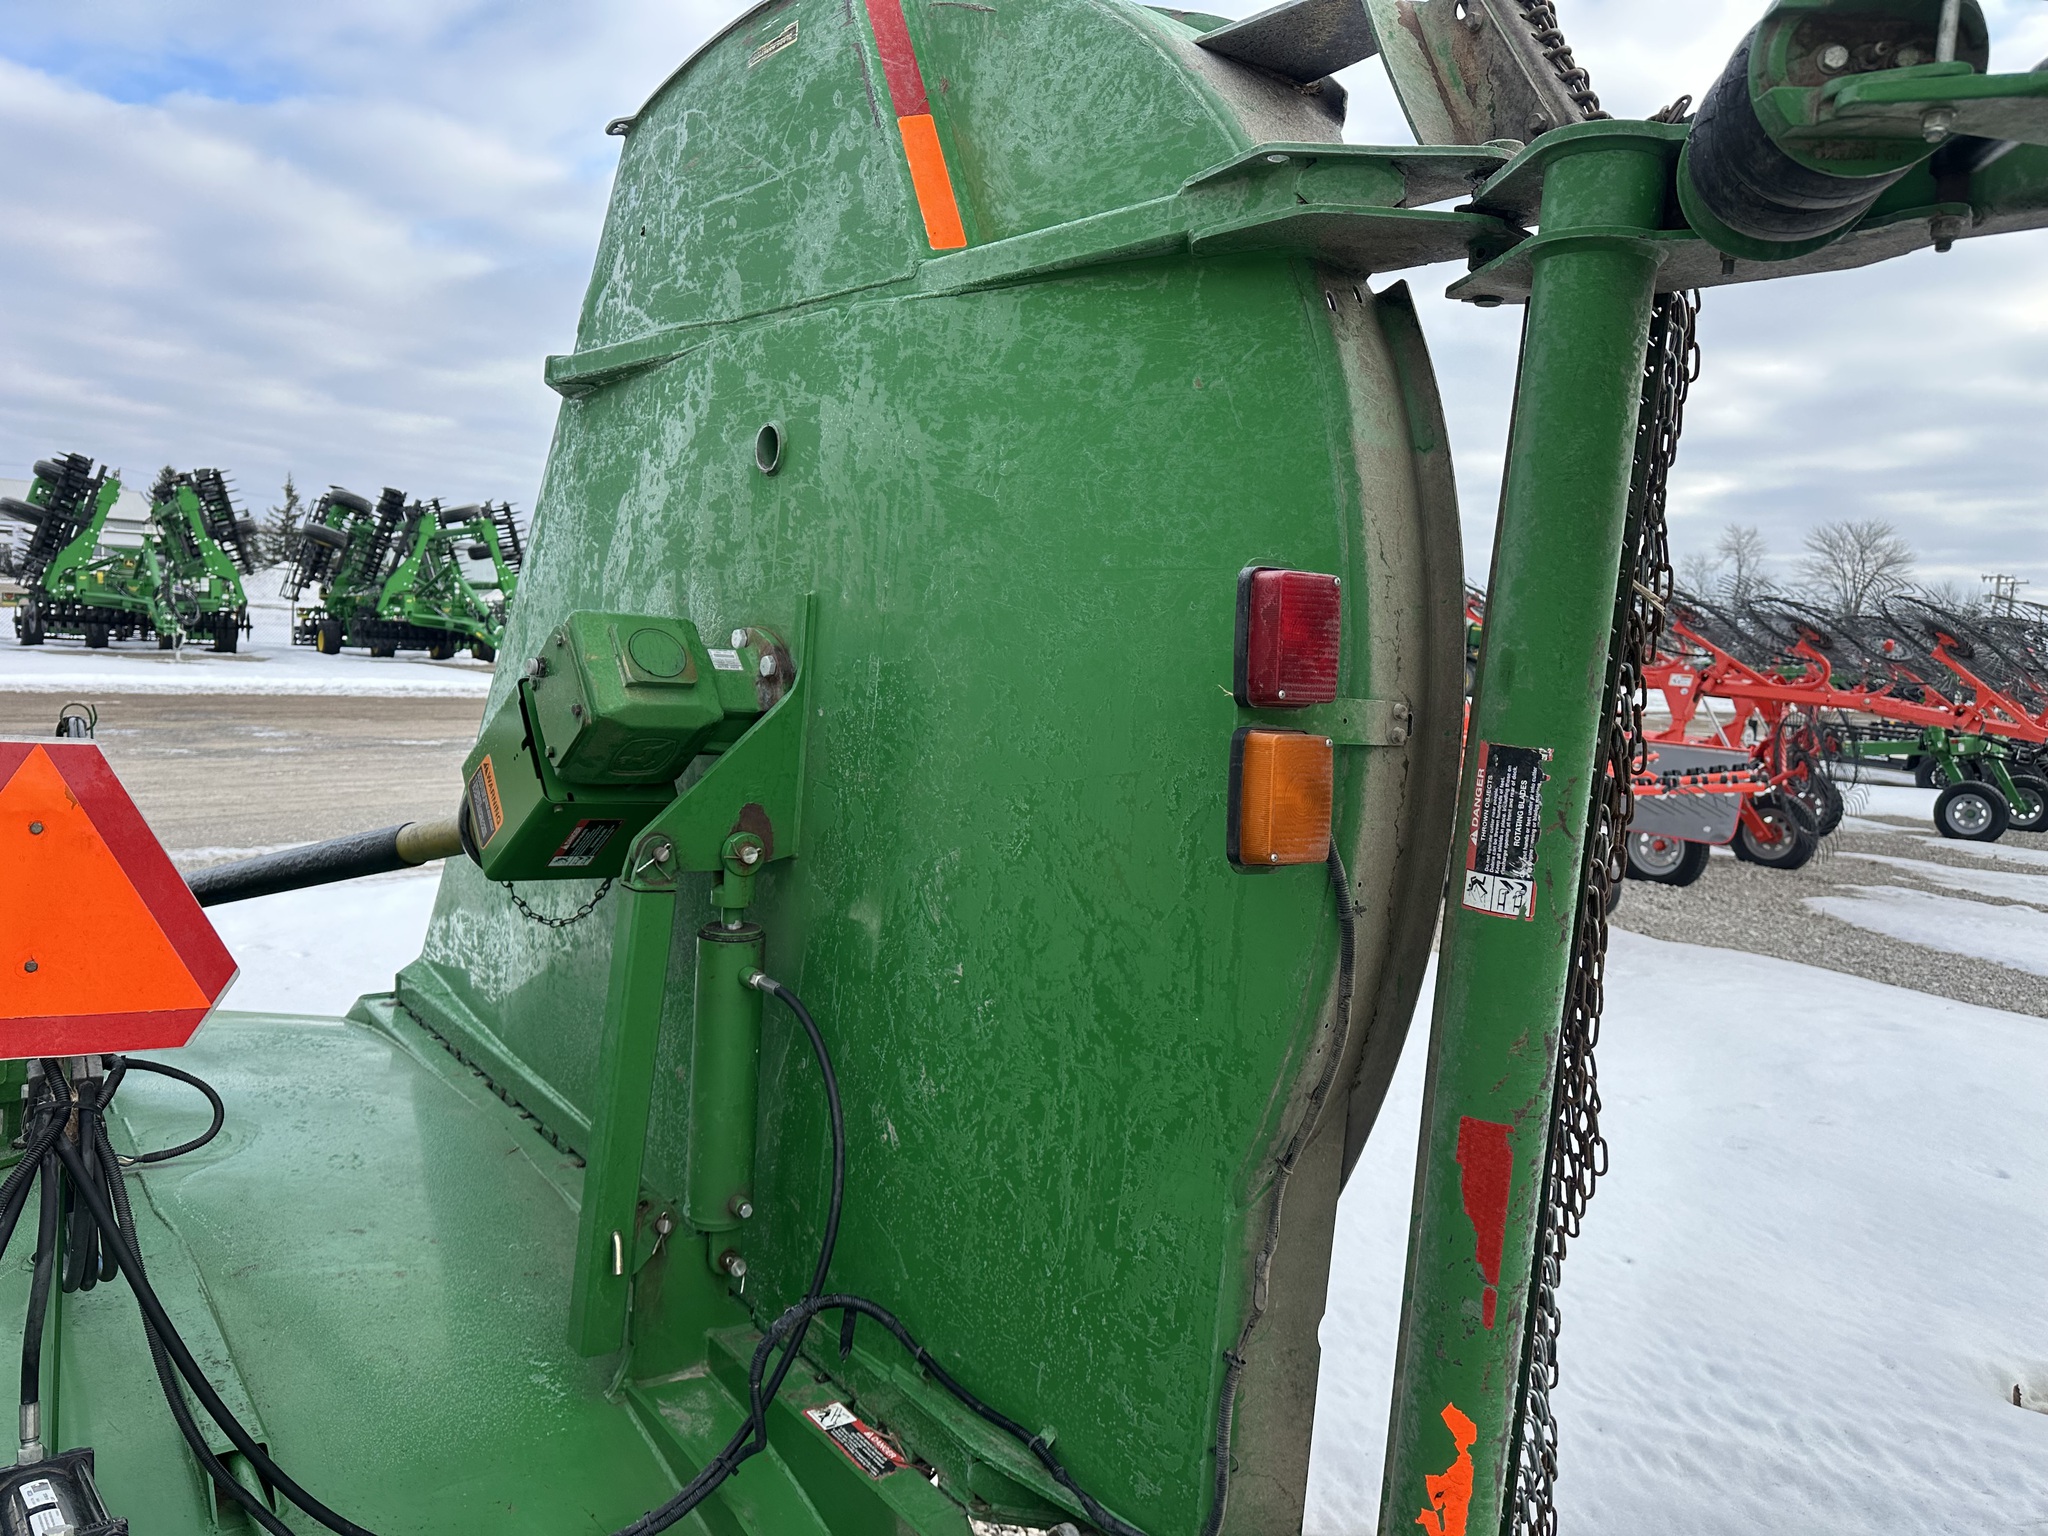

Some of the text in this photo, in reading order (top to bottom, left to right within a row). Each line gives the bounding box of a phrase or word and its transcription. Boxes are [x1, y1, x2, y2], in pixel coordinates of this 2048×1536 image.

[1530, 766, 1538, 782] cutter
[485, 771, 502, 825] WARNING
[1471, 767, 1485, 827] DANGER
[1516, 778, 1528, 809] BLADES
[1480, 774, 1493, 841] THROWN OBJECTS
[1495, 794, 1503, 819] hundreds
[1503, 827, 1511, 849] opening
[1512, 810, 1524, 847] ROTATING
[1486, 833, 1494, 854] operate
[1496, 833, 1504, 852] shields
[1494, 859, 1502, 874] Keep
[871, 1436, 897, 1459] DANGER
